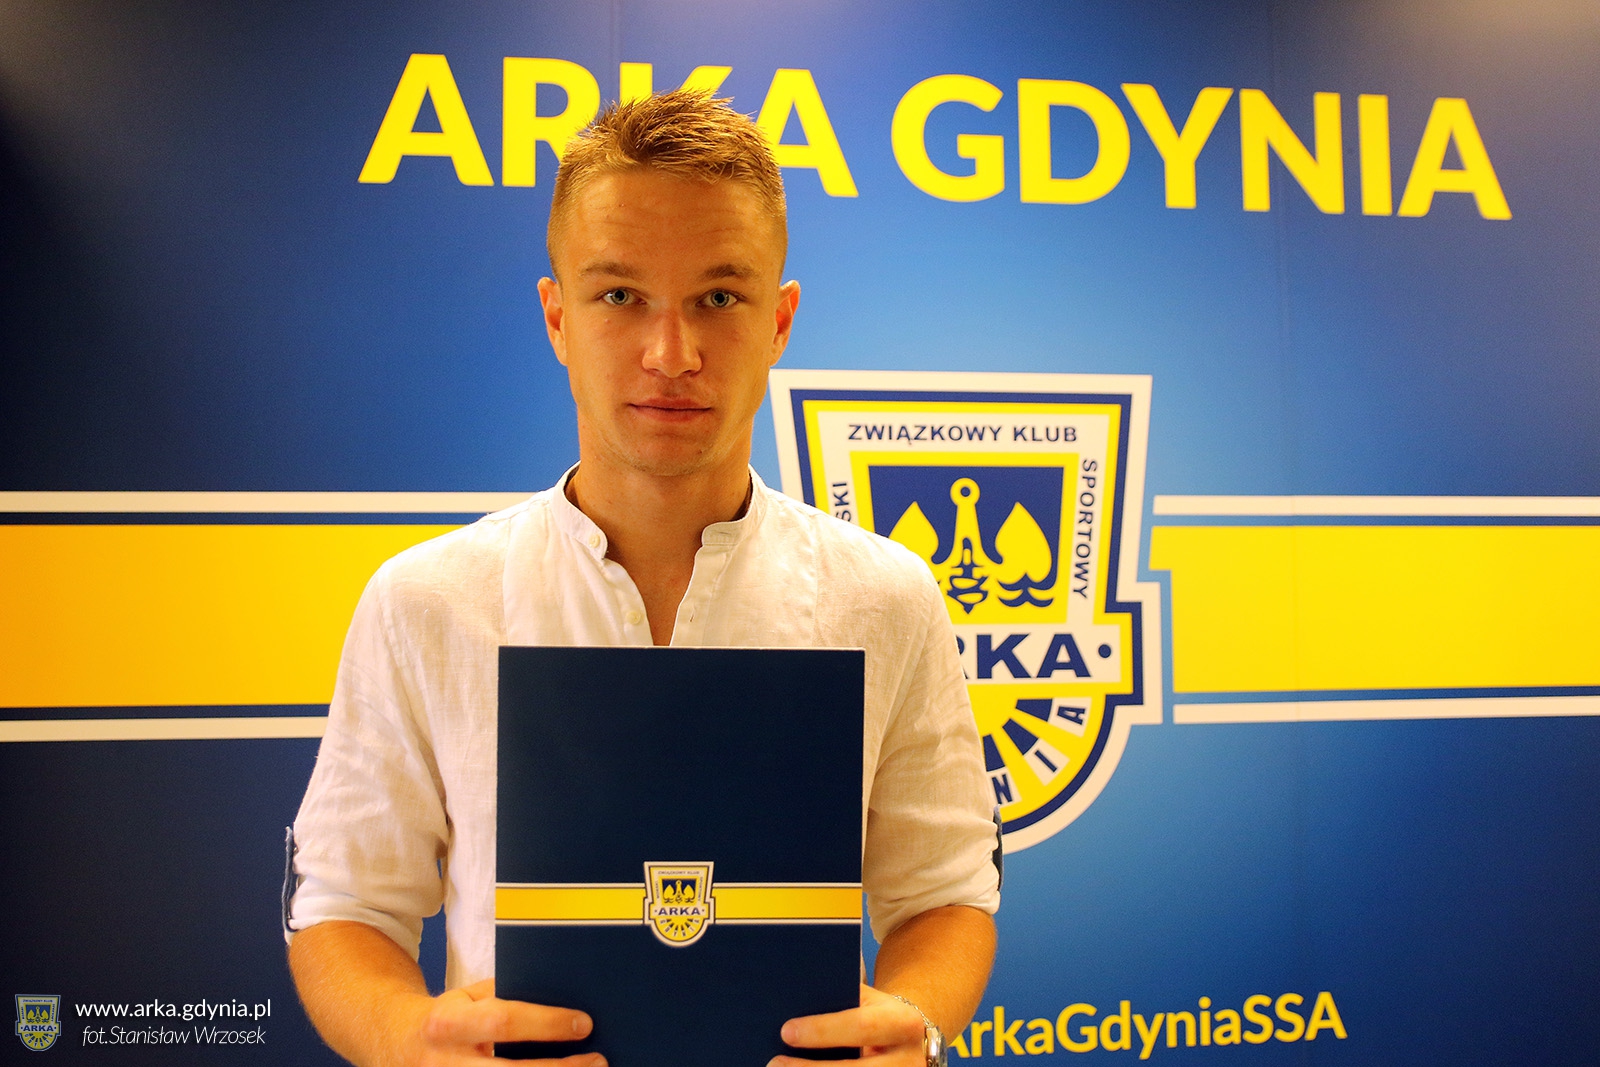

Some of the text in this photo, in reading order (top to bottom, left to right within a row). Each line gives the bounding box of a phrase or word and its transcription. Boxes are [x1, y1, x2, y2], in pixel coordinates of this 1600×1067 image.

[358, 53, 1513, 220] ARA GDYNIA
[848, 423, 1078, 446] ZWIĄZKOWY KLUB
[1072, 457, 1098, 600] SPORTOWY
[658, 907, 701, 916] ARKA
[947, 991, 1348, 1060] rkaGdyniaSSA
